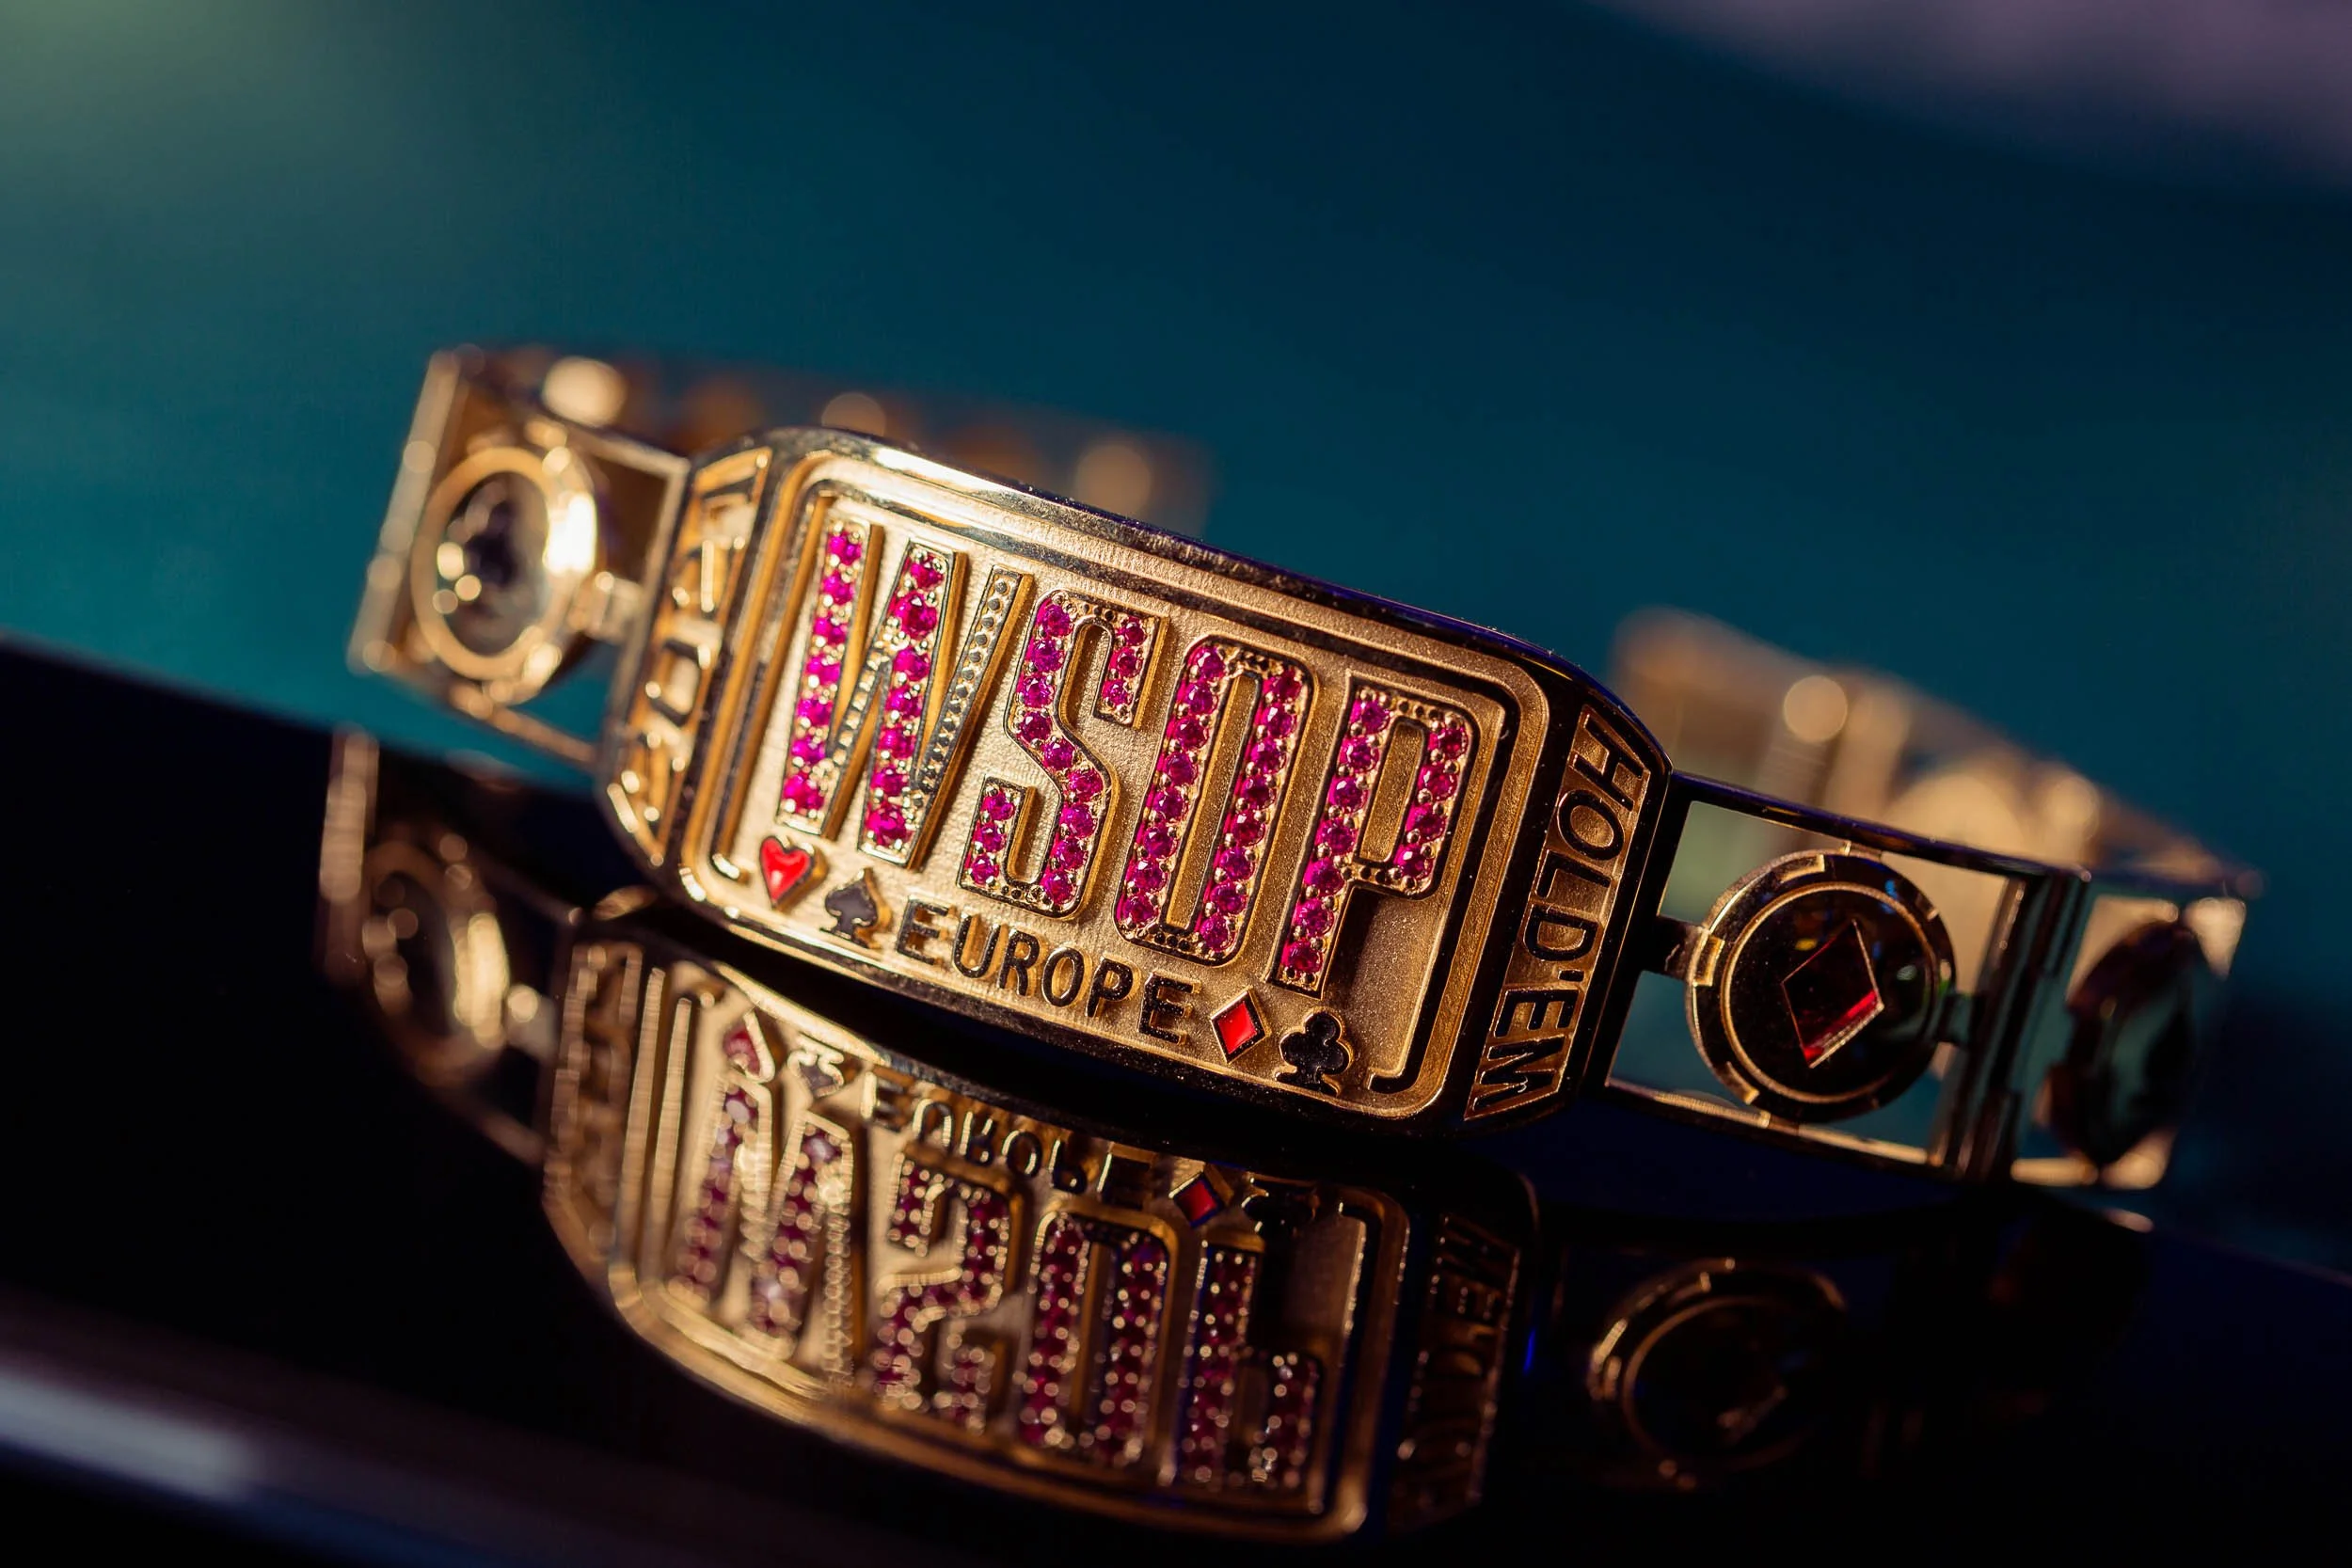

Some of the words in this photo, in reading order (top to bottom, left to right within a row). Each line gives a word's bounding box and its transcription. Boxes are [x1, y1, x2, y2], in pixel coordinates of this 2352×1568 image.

[777, 518, 1481, 995] WSOP
[1470, 709, 1645, 1114] HOLD'EM
[894, 895, 1200, 1042] EUROPE
